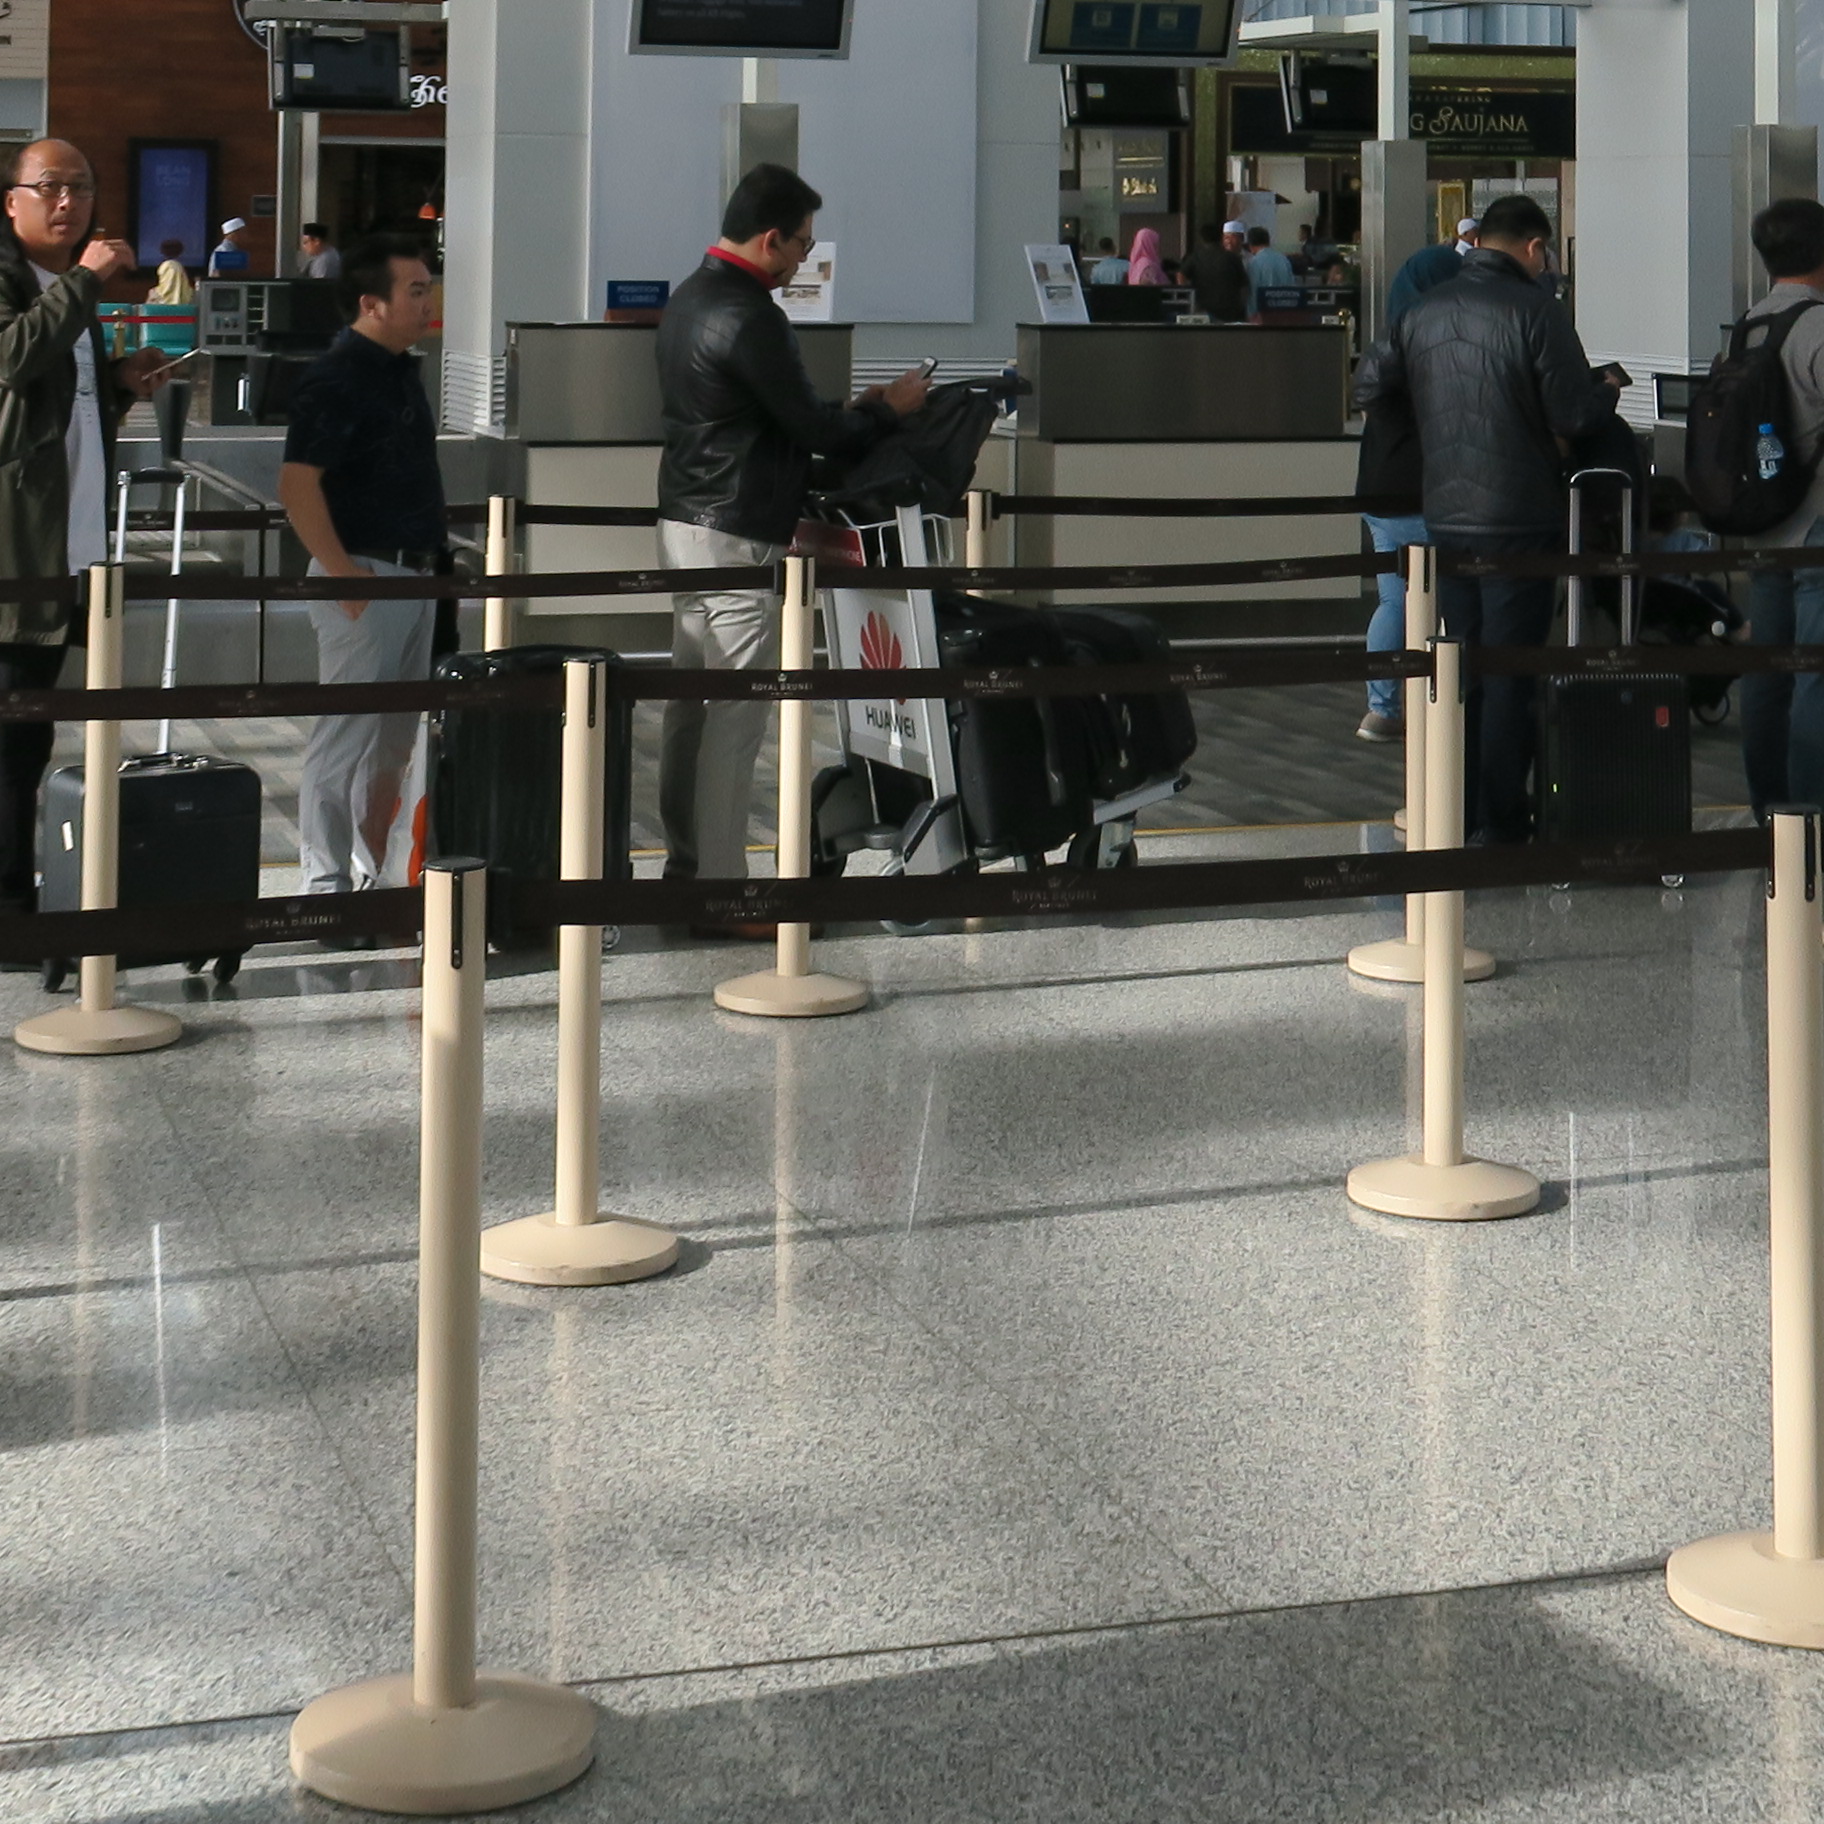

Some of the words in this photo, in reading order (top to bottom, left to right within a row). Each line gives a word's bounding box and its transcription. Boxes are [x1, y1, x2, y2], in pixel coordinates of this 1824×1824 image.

[617, 285, 660, 294] POSITION
[619, 295, 658, 303] CLOSED
[865, 706, 916, 739] HUAWEI
[1012, 889, 1049, 904] ROYAL
[1052, 888, 1097, 902] BRUNEI
